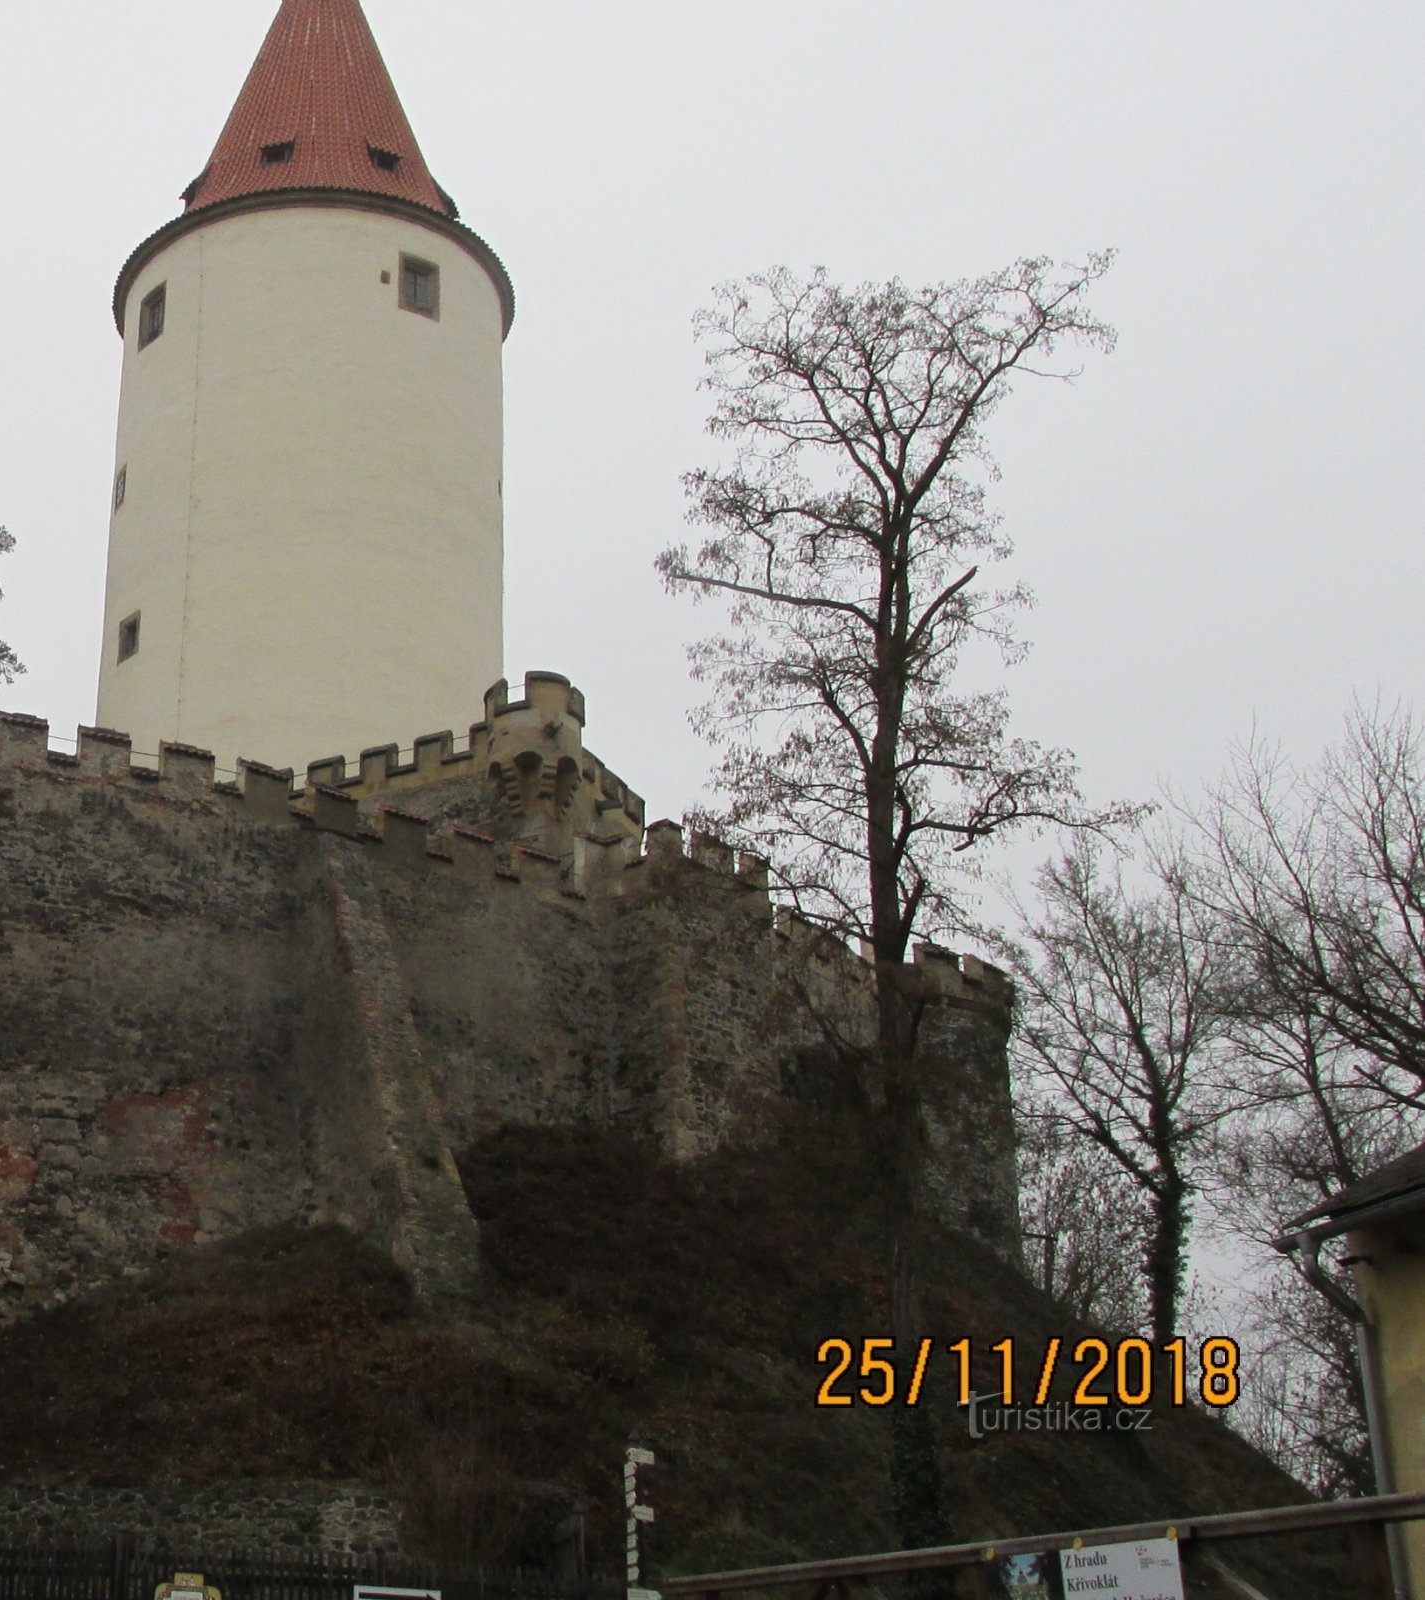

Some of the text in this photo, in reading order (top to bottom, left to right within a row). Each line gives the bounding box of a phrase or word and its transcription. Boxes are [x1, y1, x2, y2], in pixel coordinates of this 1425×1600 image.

[1064, 1551, 1107, 1569] Z hradu
[1067, 1573, 1119, 1592] Křivoklát
